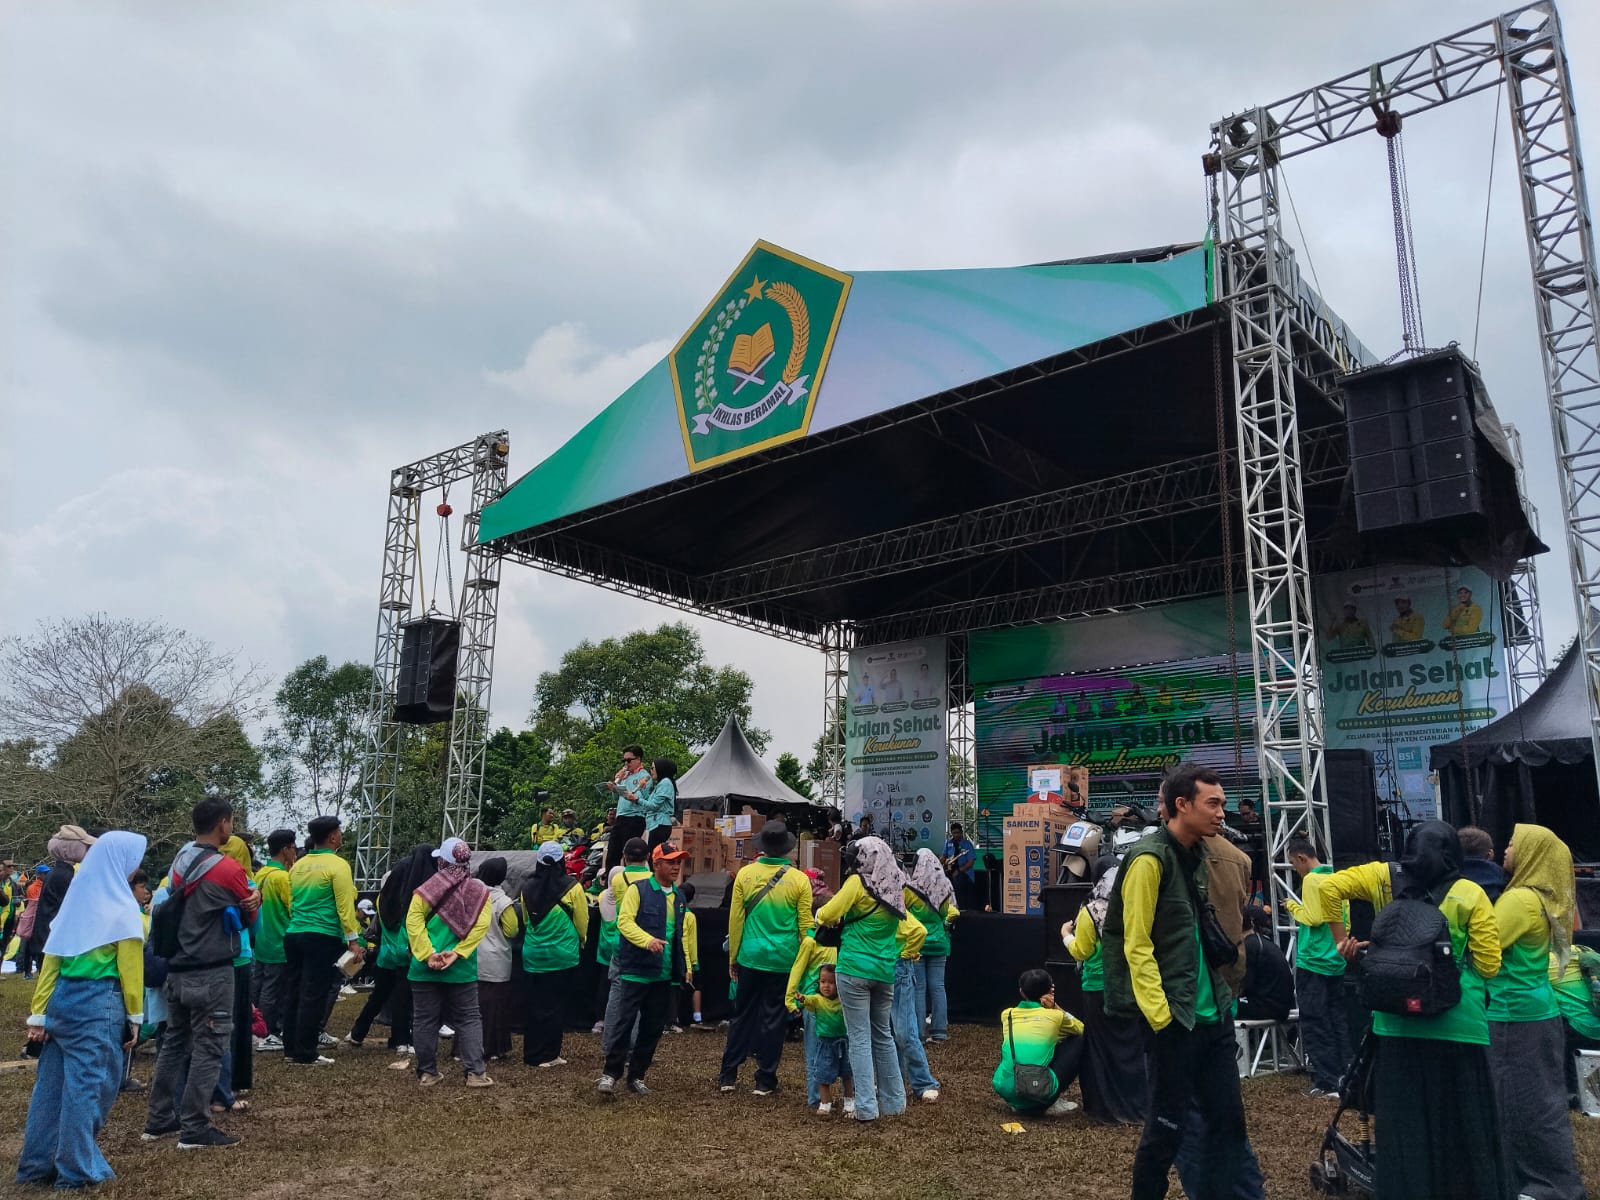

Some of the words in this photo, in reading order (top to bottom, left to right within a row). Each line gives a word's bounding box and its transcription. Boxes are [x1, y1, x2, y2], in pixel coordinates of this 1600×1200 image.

[713, 408, 742, 426] IKHLAS
[744, 386, 786, 424] BERAMAL
[1328, 667, 1405, 693] Jalan
[1409, 657, 1500, 686] Sehat
[1357, 685, 1463, 716] Kerukunan
[849, 720, 890, 737] Jalan
[893, 714, 942, 734] Sehat
[1032, 727, 1113, 754] Jalan
[1121, 716, 1221, 748] Sehat
[863, 734, 921, 755] Kerukunan
[1068, 749, 1182, 775] Kerukunan
[1007, 820, 1040, 828] SANKEN
